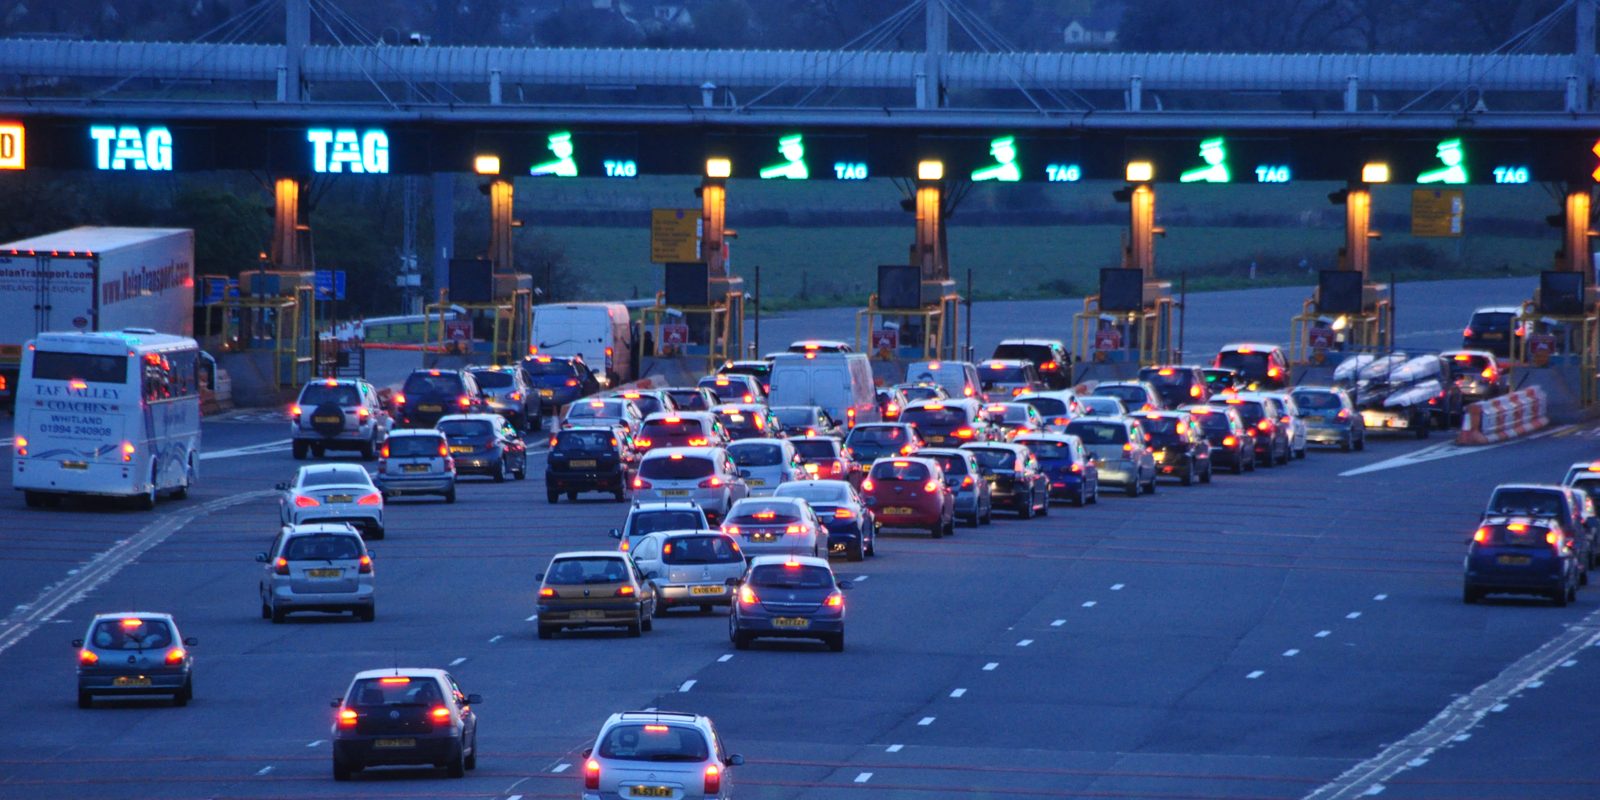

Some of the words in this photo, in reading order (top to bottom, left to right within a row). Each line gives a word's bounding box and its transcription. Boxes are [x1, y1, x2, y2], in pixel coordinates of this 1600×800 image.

[90, 125, 172, 171] TAG
[307, 128, 389, 174] TAG
[604, 160, 637, 177] TAG
[834, 163, 867, 180] TAG
[1046, 164, 1080, 181] TAG
[1255, 165, 1290, 182] TAG
[1493, 166, 1529, 183] TAG
[34, 384, 61, 396] TAF
[64, 386, 121, 400] VALLEY
[47, 400, 108, 412] COACHES
[51, 415, 103, 425] WHITLAND
